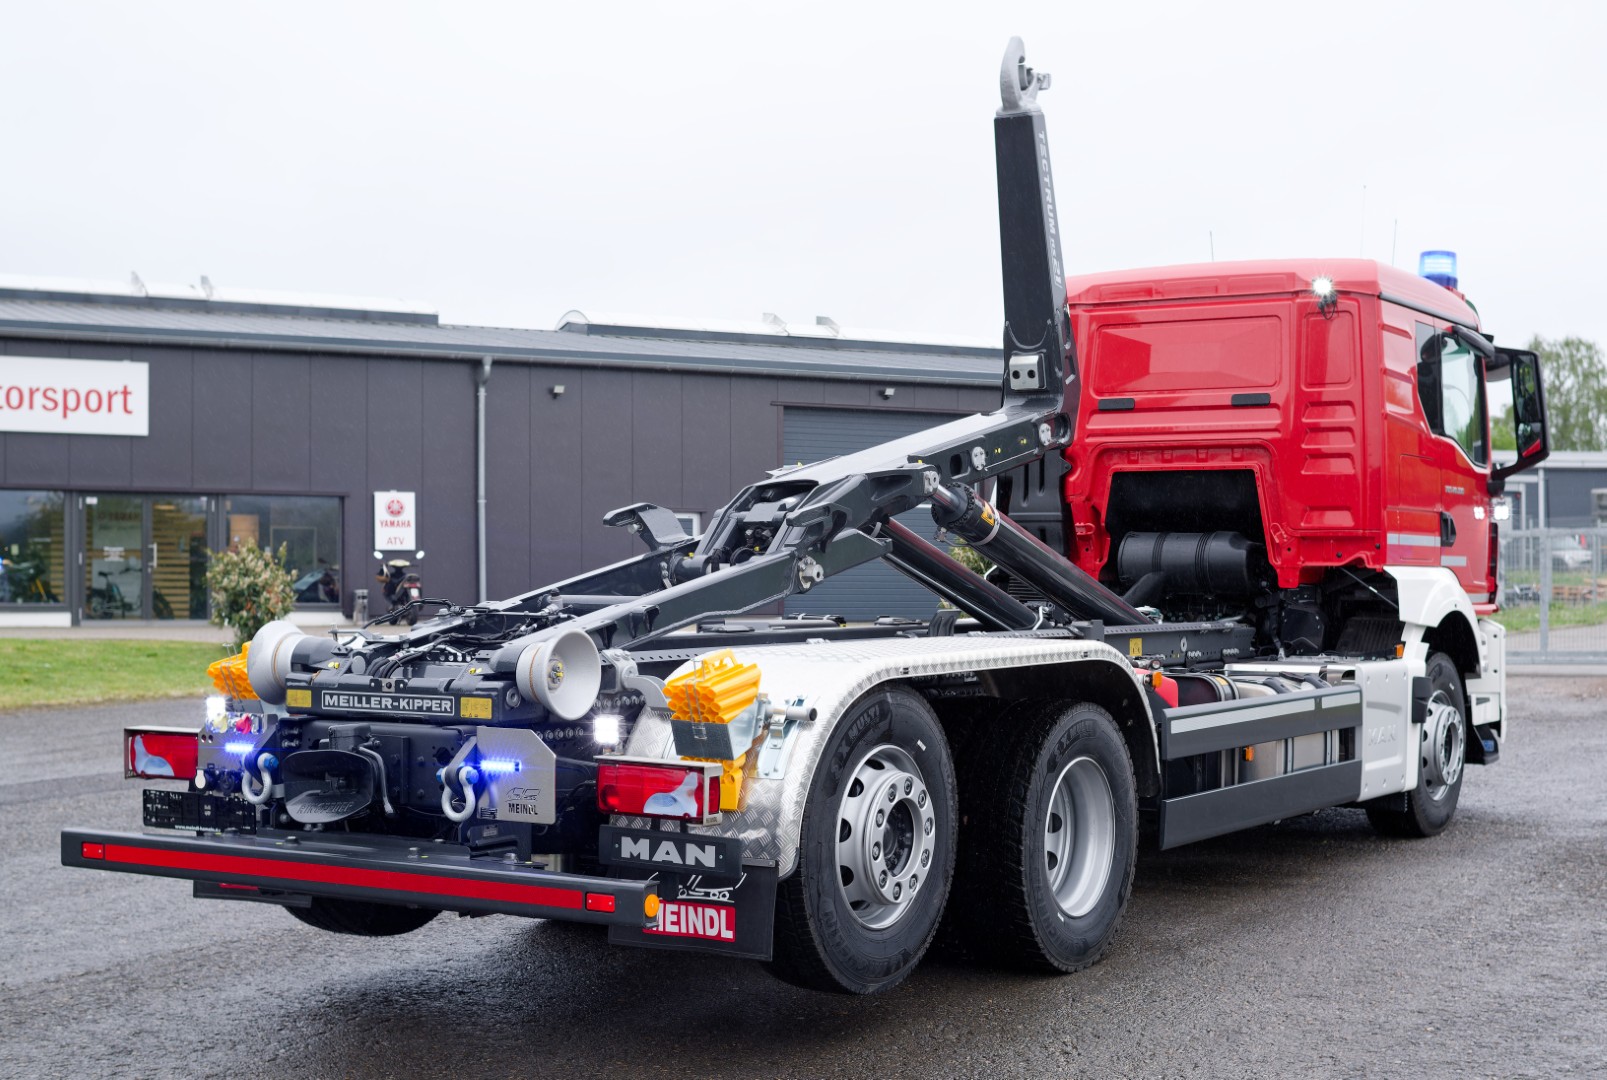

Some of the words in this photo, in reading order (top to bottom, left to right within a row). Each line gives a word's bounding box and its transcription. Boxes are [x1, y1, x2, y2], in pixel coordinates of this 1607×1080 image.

[1038, 130, 1057, 235] TECTRUM
[0, 384, 133, 419] orsport
[380, 519, 411, 528] YAMAHA
[387, 536, 404, 546] ATV
[324, 694, 452, 712] MEILLER-KIPPER
[847, 704, 881, 741] MULTI
[508, 802, 538, 815] MEINDL
[621, 836, 716, 868] MAN
